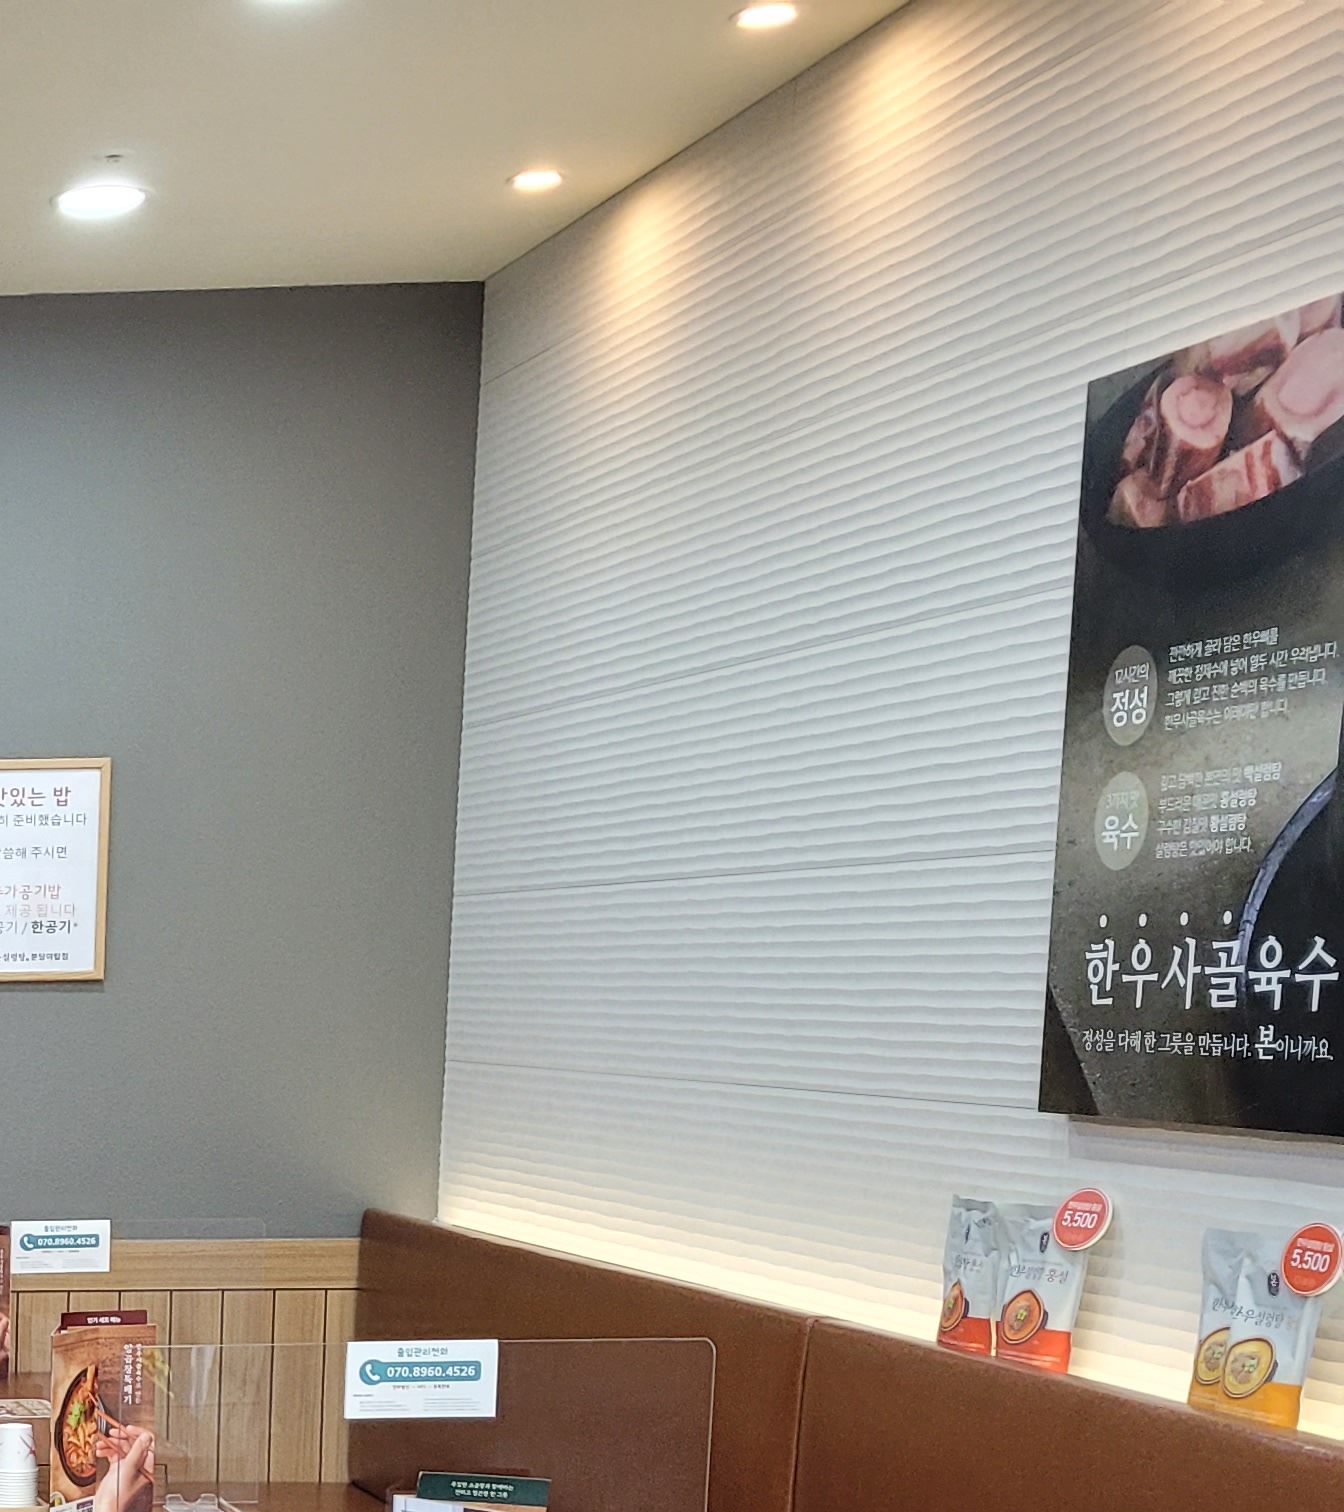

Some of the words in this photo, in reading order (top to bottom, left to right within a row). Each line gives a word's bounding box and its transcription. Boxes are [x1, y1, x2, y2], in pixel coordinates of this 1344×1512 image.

[1204, 639, 1222, 656] 골라
[1224, 635, 1241, 653] 담은
[1249, 655, 1267, 672] 열두
[1269, 652, 1288, 667] 시간
[1111, 686, 1149, 727] 정성
[53, 786, 72, 807] 밥
[13, 813, 87, 827] 준비했습니다
[1101, 813, 1140, 851] 육수
[30, 846, 67, 859] 주시면
[5, 904, 31, 916] 제공
[1085, 932, 1339, 1012] 한우사골육수
[1083, 1028, 1116, 1052] 정성을
[1118, 1030, 1140, 1054] 다해
[1144, 1032, 1157, 1053] 한
[1158, 1033, 1195, 1055] 그릇을
[1198, 1033, 1252, 1057] 만듭니다.
[37, 1237, 96, 1246] 070.8960.4526
[387, 1365, 475, 1378] 070.8960.4526
